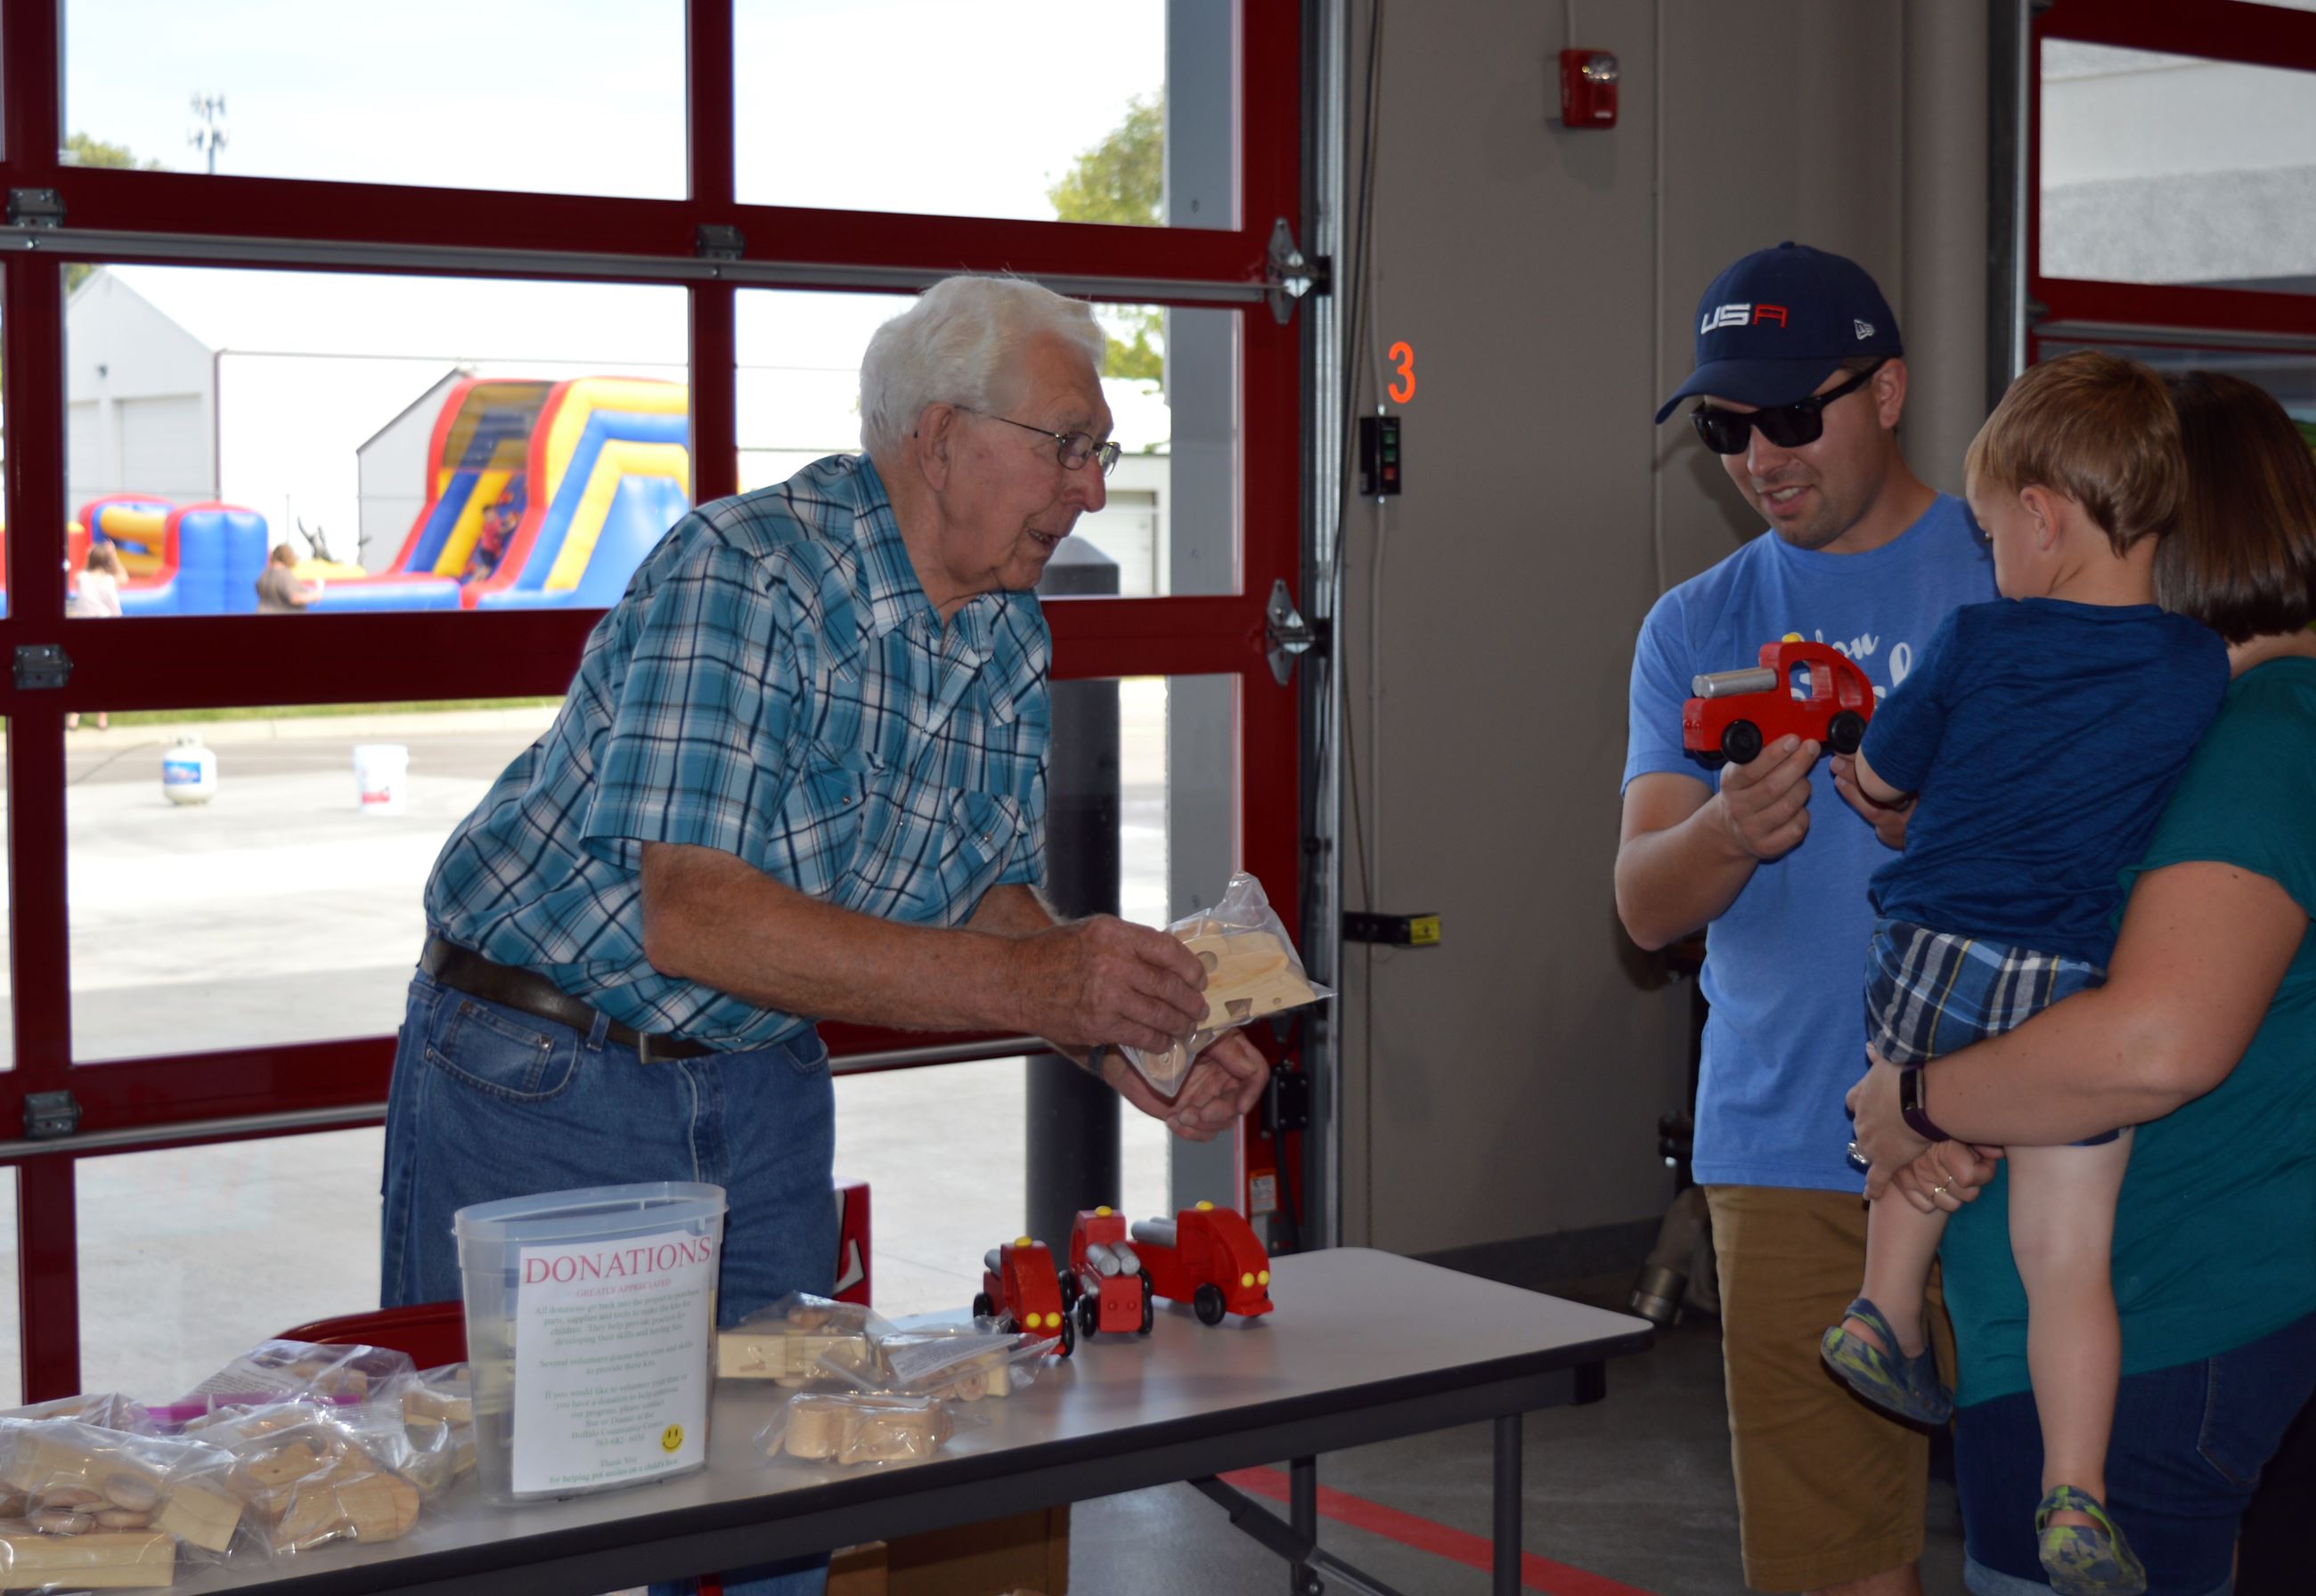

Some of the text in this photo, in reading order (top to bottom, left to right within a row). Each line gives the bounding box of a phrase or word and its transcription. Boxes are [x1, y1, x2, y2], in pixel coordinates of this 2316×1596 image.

[1700, 303, 1788, 335] USA
[1388, 341, 1415, 403] 3
[526, 1237, 712, 1284] DONATIONS
[617, 1278, 672, 1294] APPRECIATED
